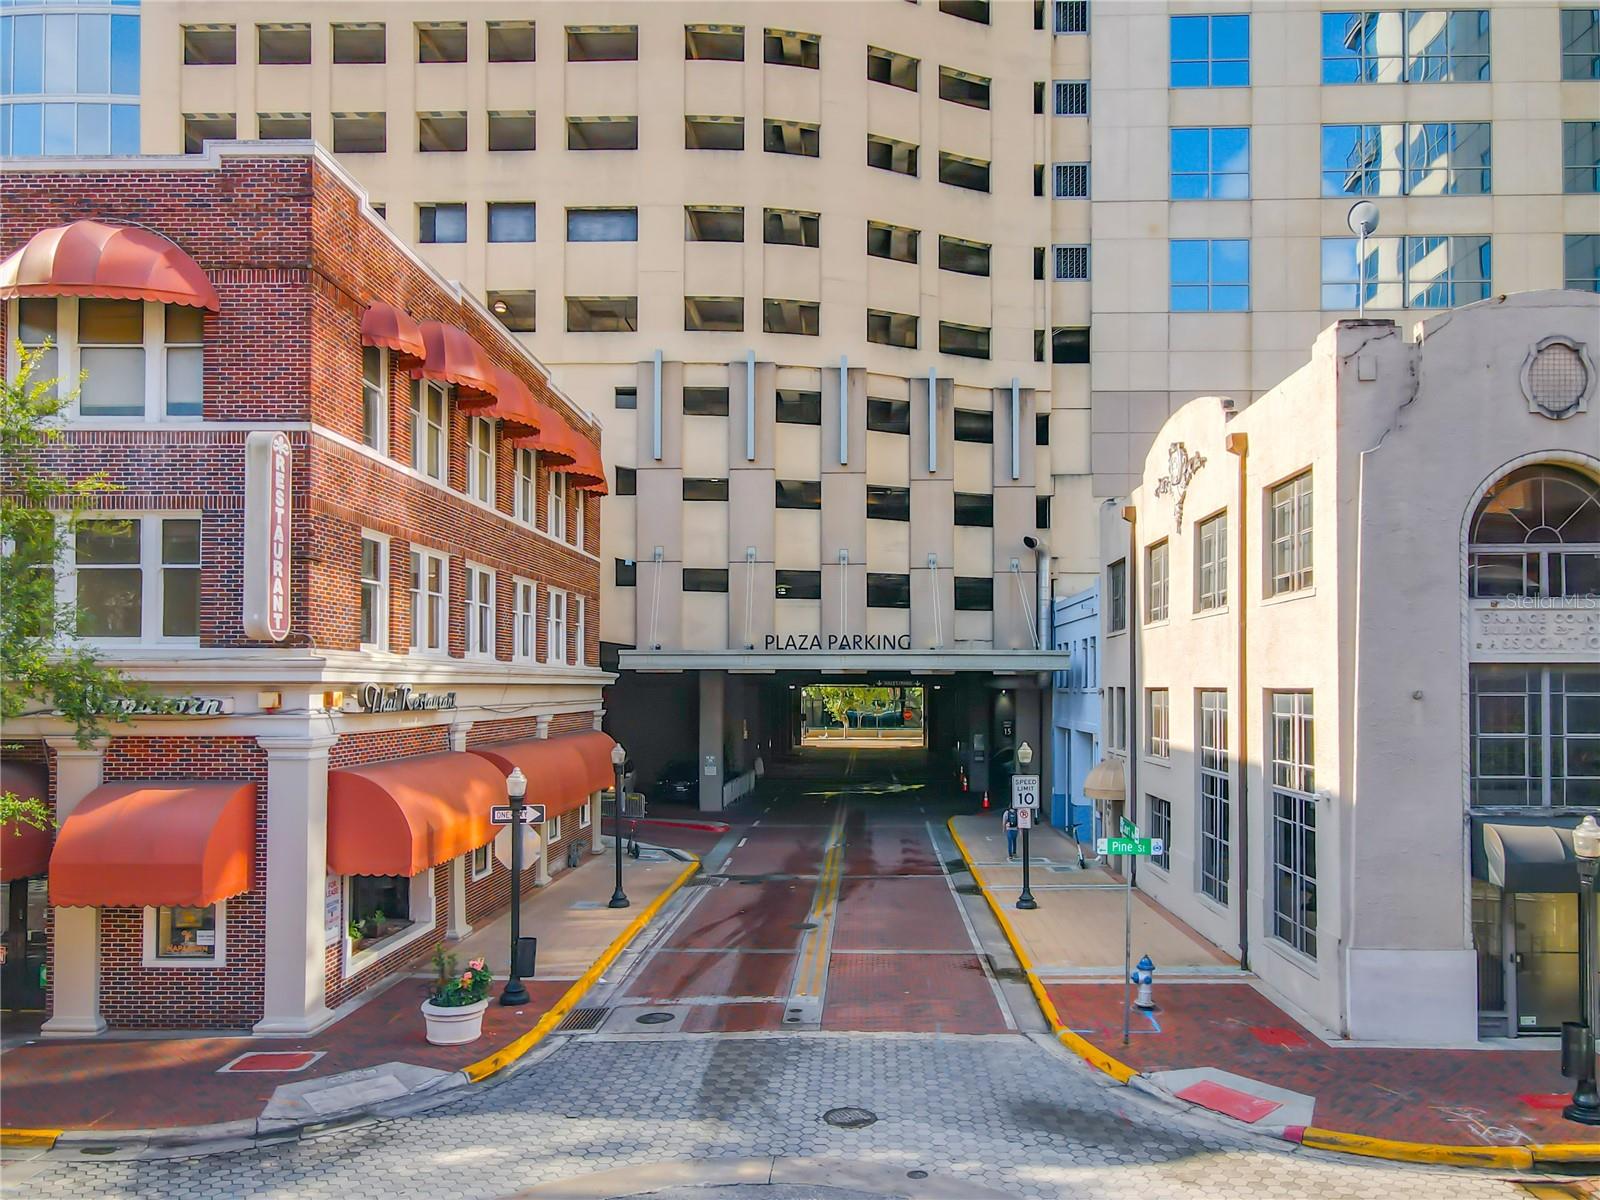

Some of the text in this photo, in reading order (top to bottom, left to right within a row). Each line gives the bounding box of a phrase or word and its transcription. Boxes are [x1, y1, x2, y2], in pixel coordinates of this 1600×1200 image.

[273, 454, 285, 629] RESTAURANT
[1481, 613, 1547, 624] ORANGE
[765, 634, 911, 650] PLAZA PARKING
[365, 683, 398, 713] Thai
[1018, 793, 1035, 805] 10
[496, 811, 510, 819] ONE
[1112, 841, 1145, 852] Pine St
